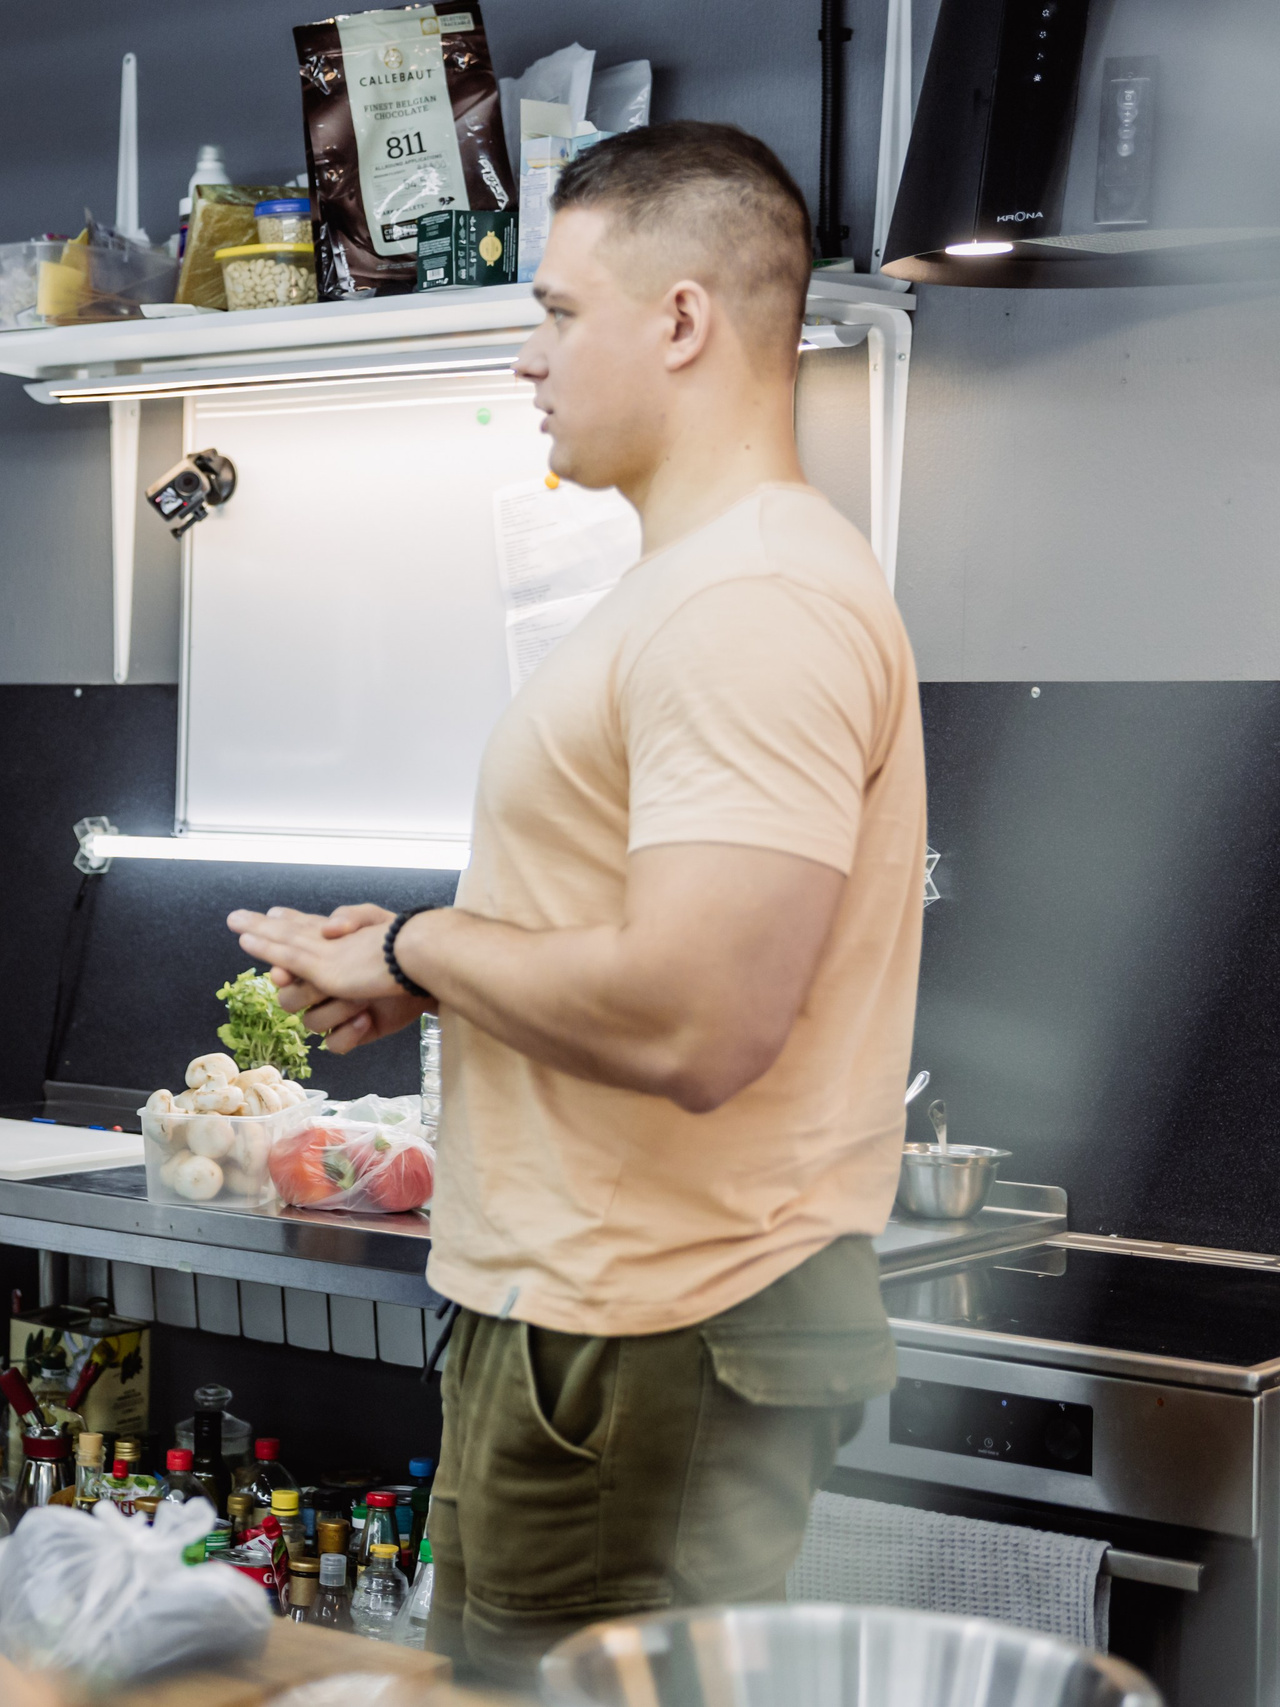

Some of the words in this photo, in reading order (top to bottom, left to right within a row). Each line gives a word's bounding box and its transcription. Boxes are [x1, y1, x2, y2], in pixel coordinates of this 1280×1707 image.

[359, 69, 433, 87] CALLEBAUT
[364, 102, 393, 112] FINEST
[396, 95, 437, 108] BELGIAN
[374, 105, 429, 120] CHOCOLATE
[386, 131, 427, 159] 811
[997, 211, 1043, 222] KRONA
